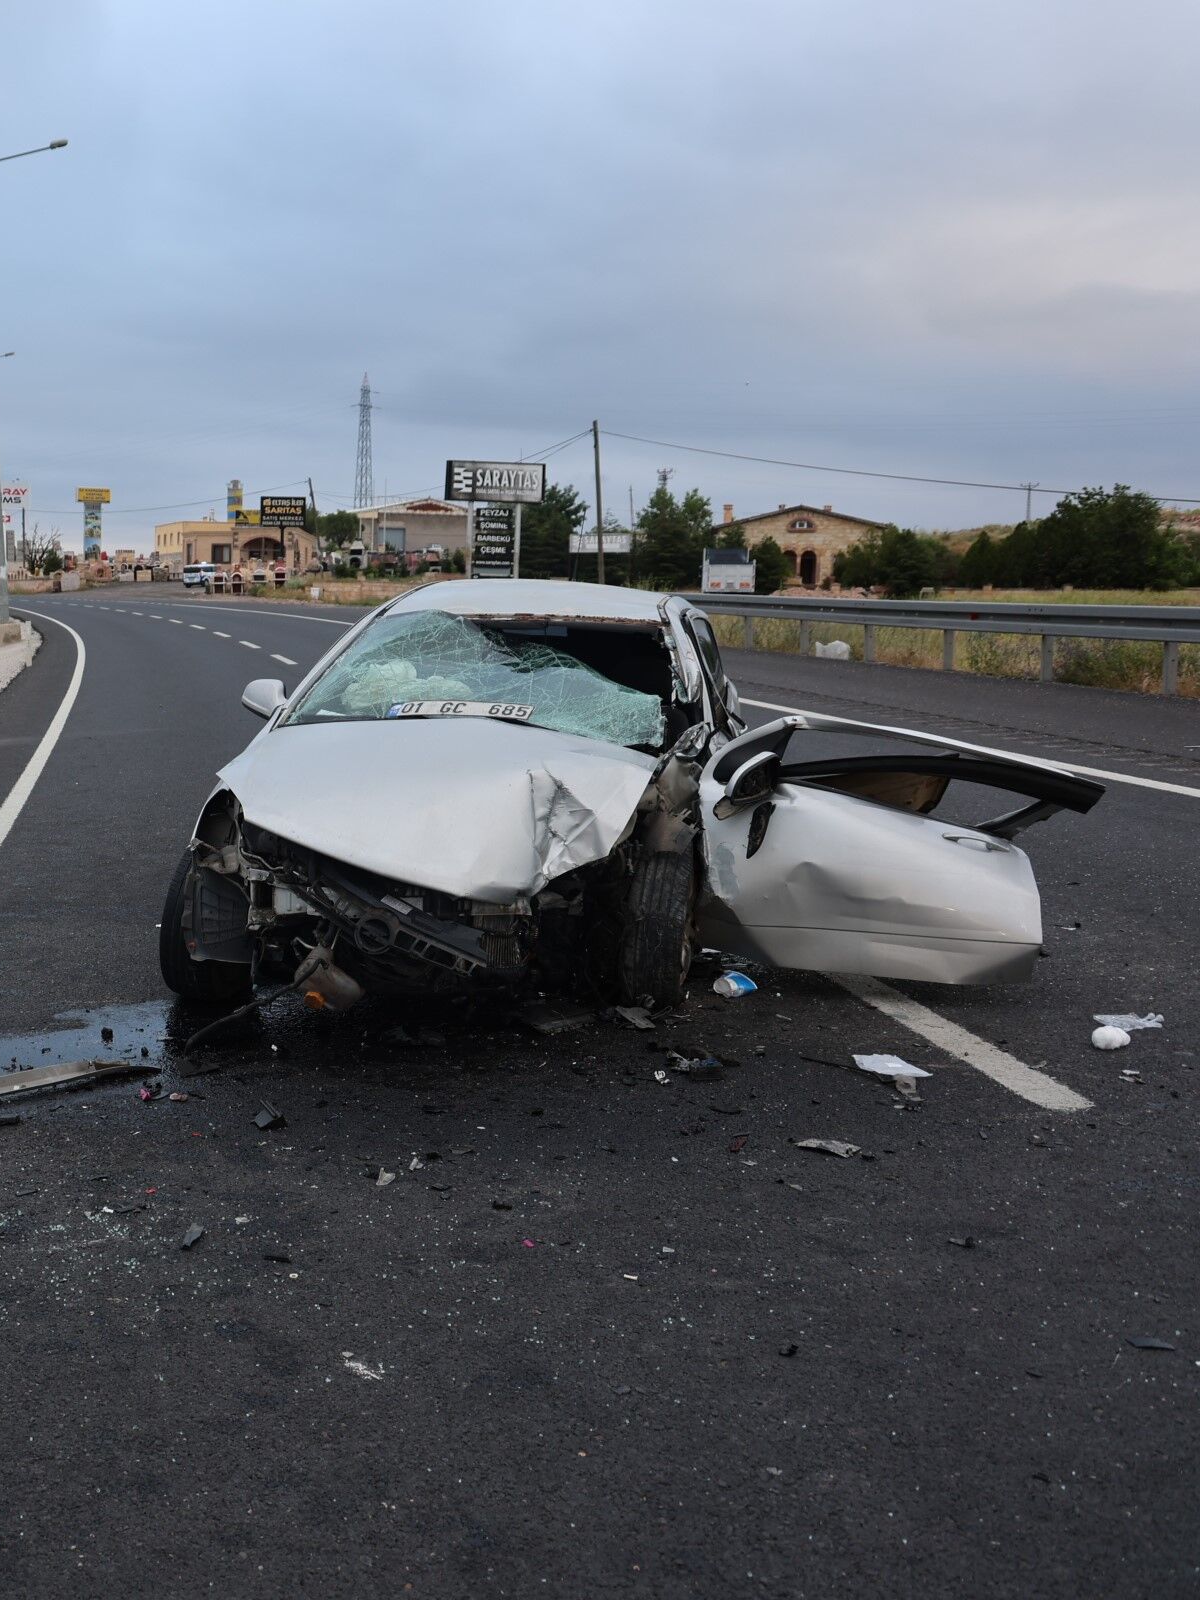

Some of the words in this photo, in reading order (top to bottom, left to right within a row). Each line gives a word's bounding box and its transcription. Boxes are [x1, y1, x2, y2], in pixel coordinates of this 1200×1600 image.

[476, 468, 538, 489] SARAYTAŞ
[480, 509, 509, 517] PEYZAJ
[480, 546, 507, 555] ÇEŞME
[401, 702, 425, 714] 01
[439, 702, 467, 714] GC
[488, 704, 531, 717] 685
